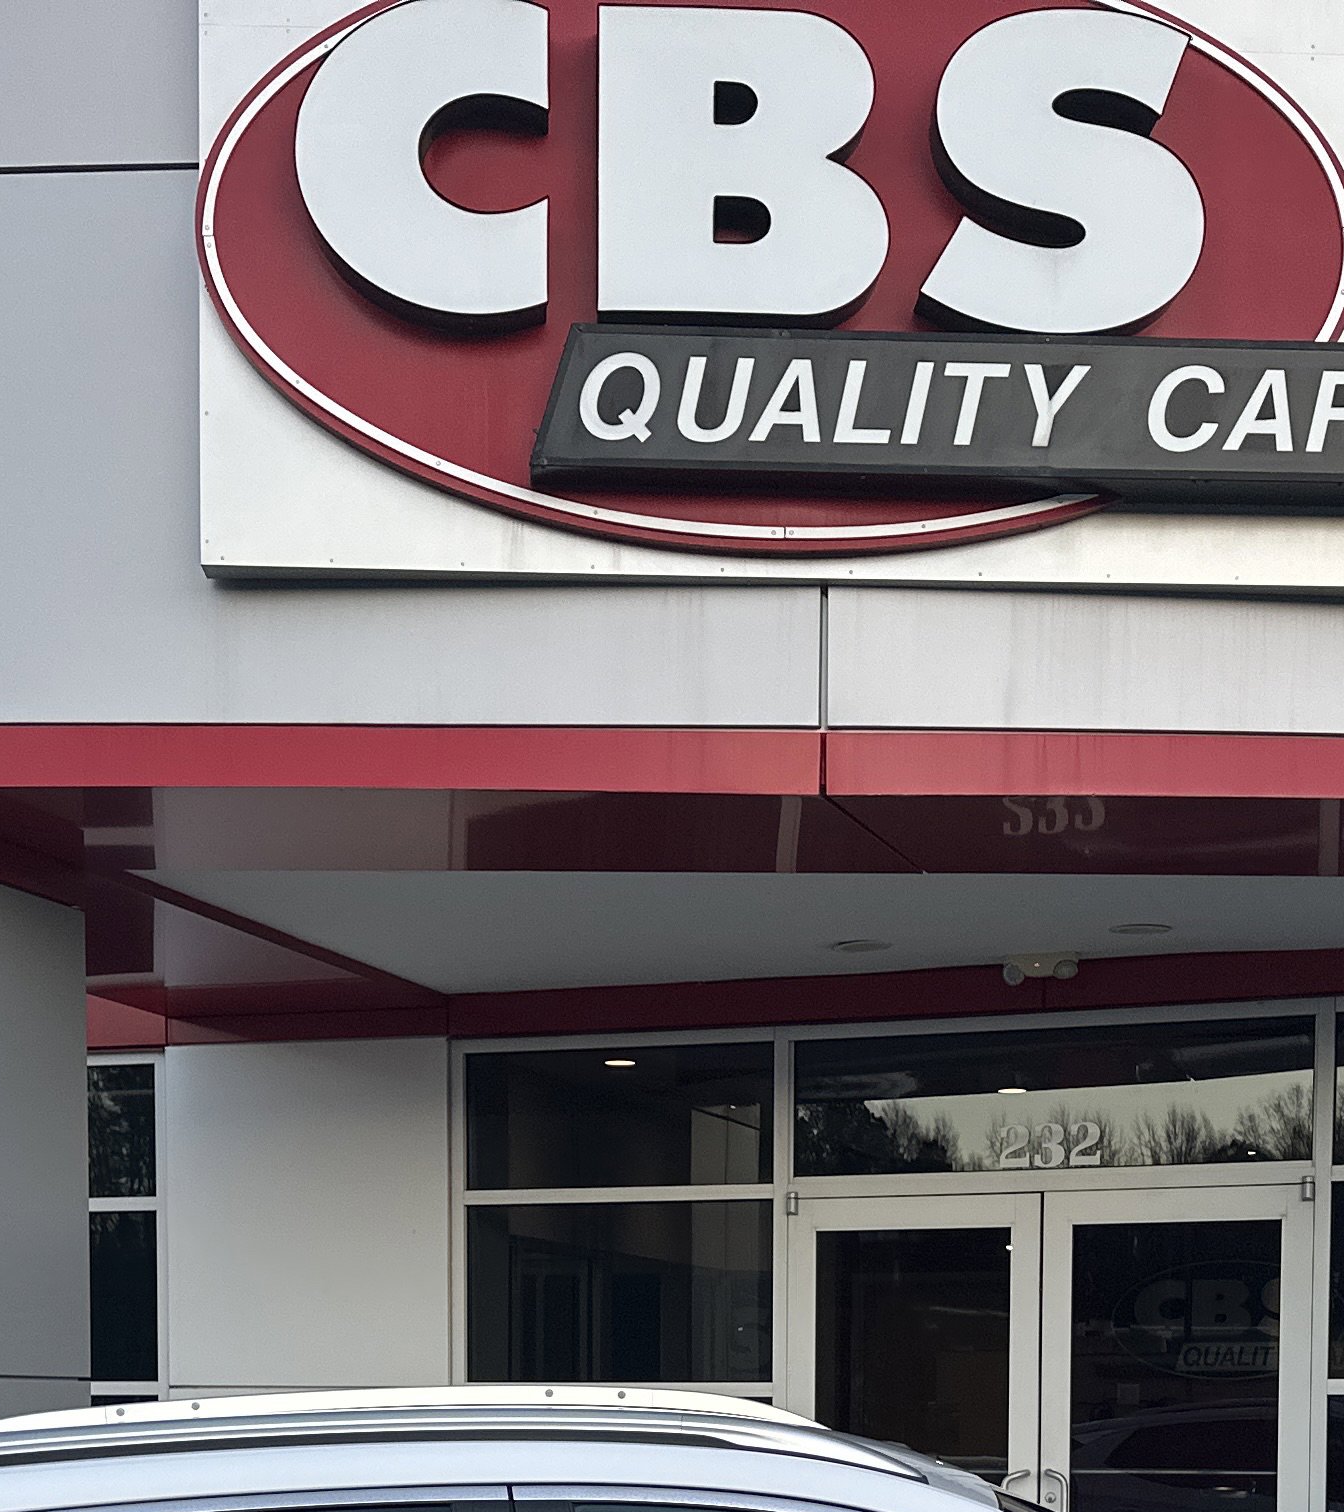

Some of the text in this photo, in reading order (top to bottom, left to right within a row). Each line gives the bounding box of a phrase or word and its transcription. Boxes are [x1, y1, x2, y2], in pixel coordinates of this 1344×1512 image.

[294, 0, 1207, 337] CBS
[577, 351, 1089, 448] QUALITY
[1000, 1121, 1101, 1168] 232
[1182, 1345, 1276, 1366] QUALIT
